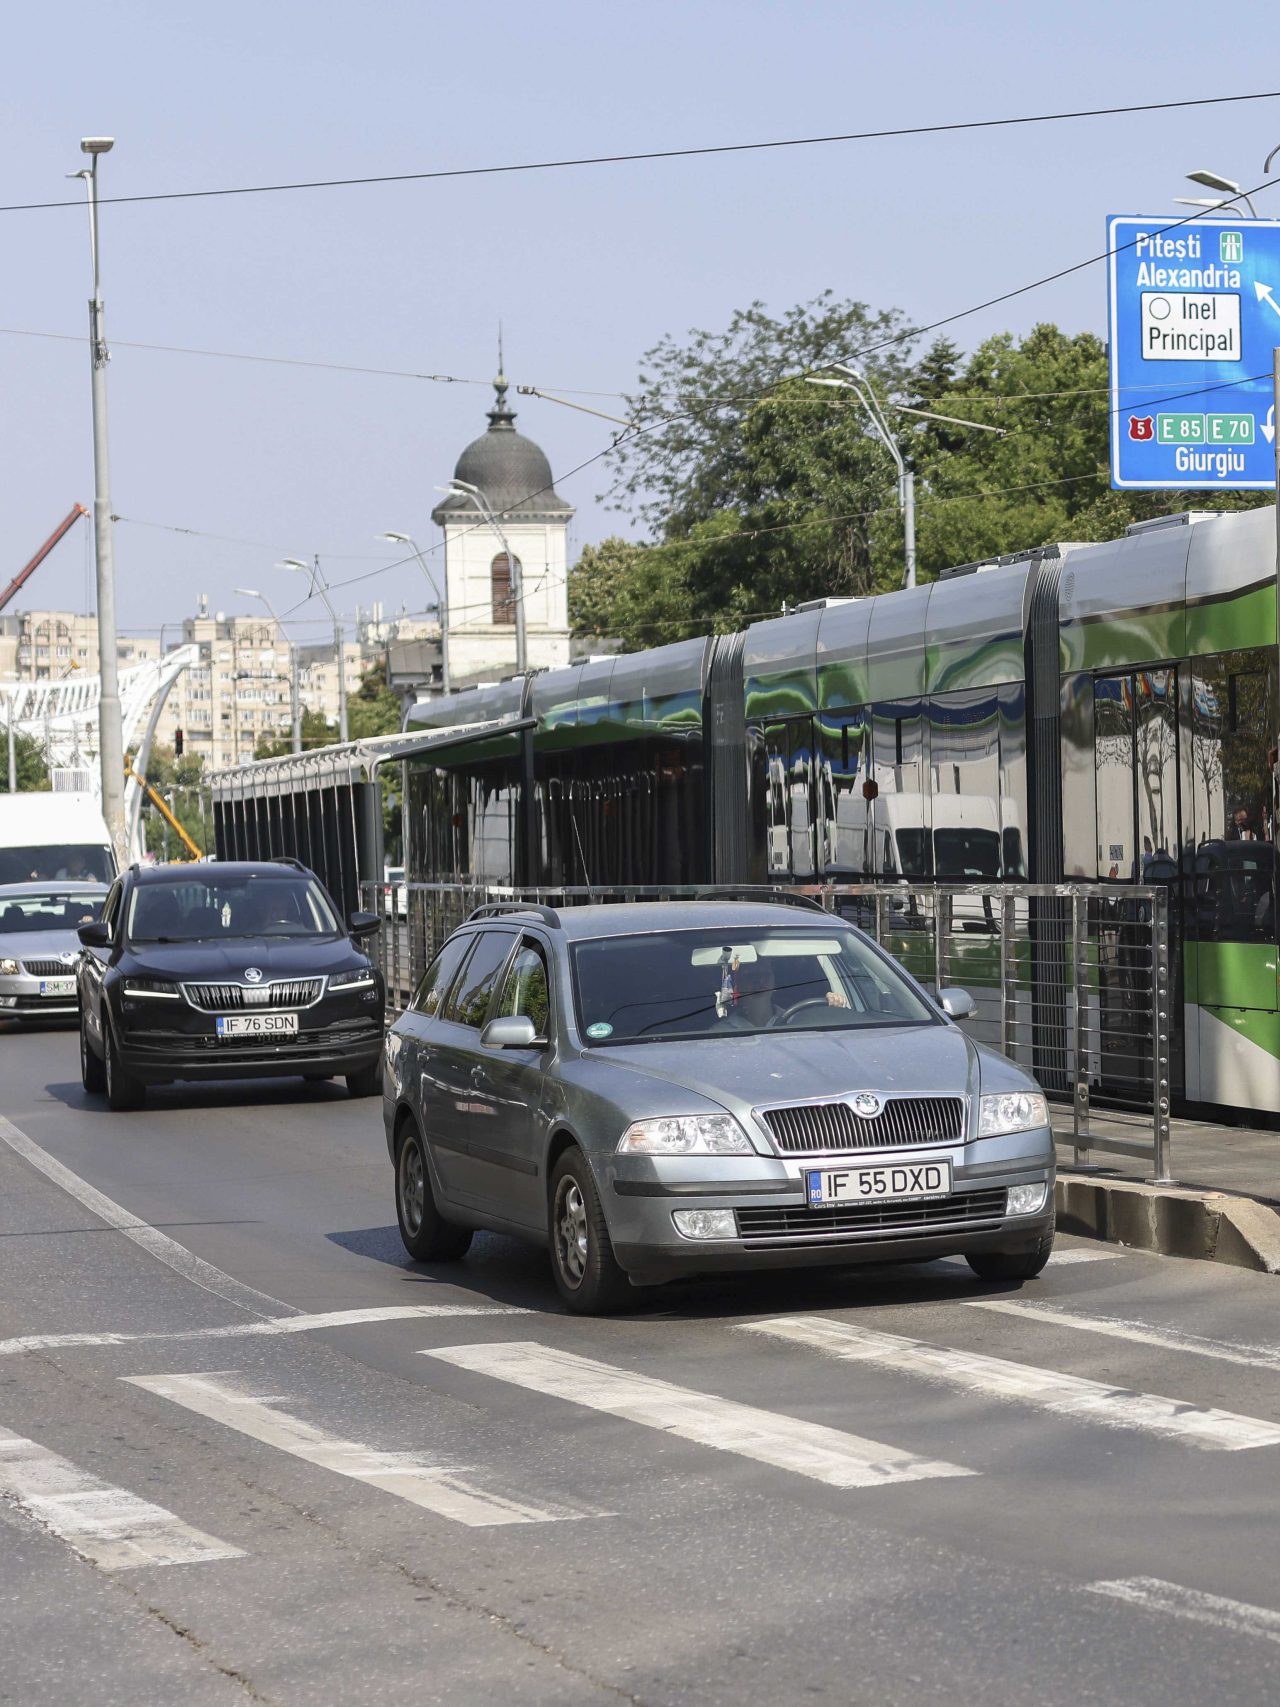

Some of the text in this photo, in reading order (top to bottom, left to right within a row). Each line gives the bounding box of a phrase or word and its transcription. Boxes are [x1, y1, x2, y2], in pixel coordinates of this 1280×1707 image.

[1136, 232, 1200, 261] Pitești
[1136, 262, 1241, 289] Alexandria
[1182, 296, 1216, 320] Inel
[1149, 326, 1233, 357] Principal
[1137, 422, 1145, 436] 5
[1163, 419, 1201, 438] E 85
[1212, 419, 1250, 438] E 70
[1175, 446, 1245, 477] Giurgiu
[226, 1019, 239, 1032] IF
[244, 1018, 261, 1031] 76
[264, 1016, 295, 1030] SDN
[811, 1189, 822, 1200] RO
[827, 1167, 942, 1199] IF 55 DXD
